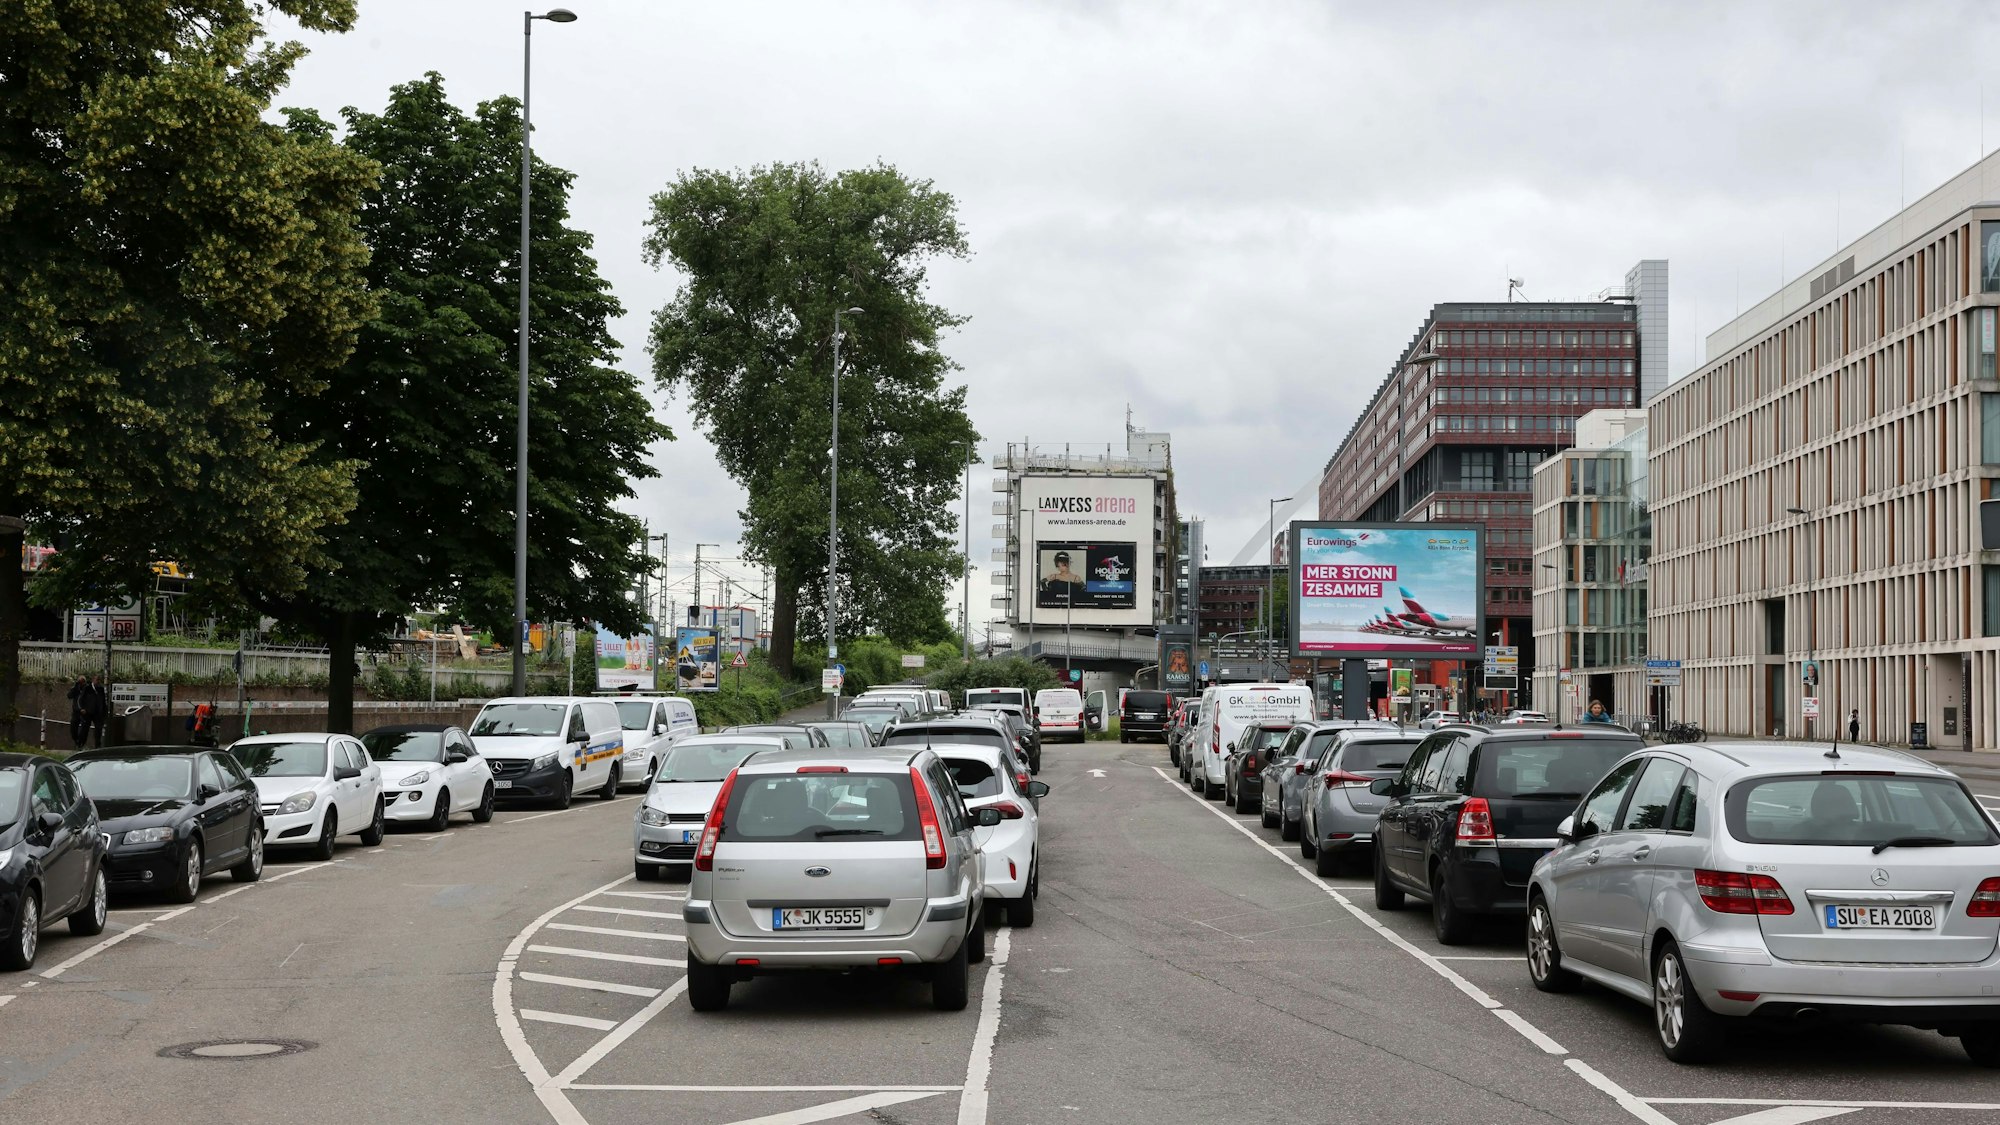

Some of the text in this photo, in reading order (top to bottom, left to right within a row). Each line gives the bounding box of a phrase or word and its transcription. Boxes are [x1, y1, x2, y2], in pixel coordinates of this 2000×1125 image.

[1039, 497, 1136, 513] LANXESS arena
[1307, 537, 1357, 548] Eurowings
[1095, 567, 1130, 575] HOLIDAY
[1307, 566, 1393, 579] MER STONN
[1307, 583, 1379, 596] ZESAMME
[115, 622, 132, 634] DB
[1229, 696, 1301, 704] GK GmbH
[690, 832, 695, 841] K
[782, 910, 862, 925] K JK 5555
[1838, 908, 1932, 925] SU EA 2008
